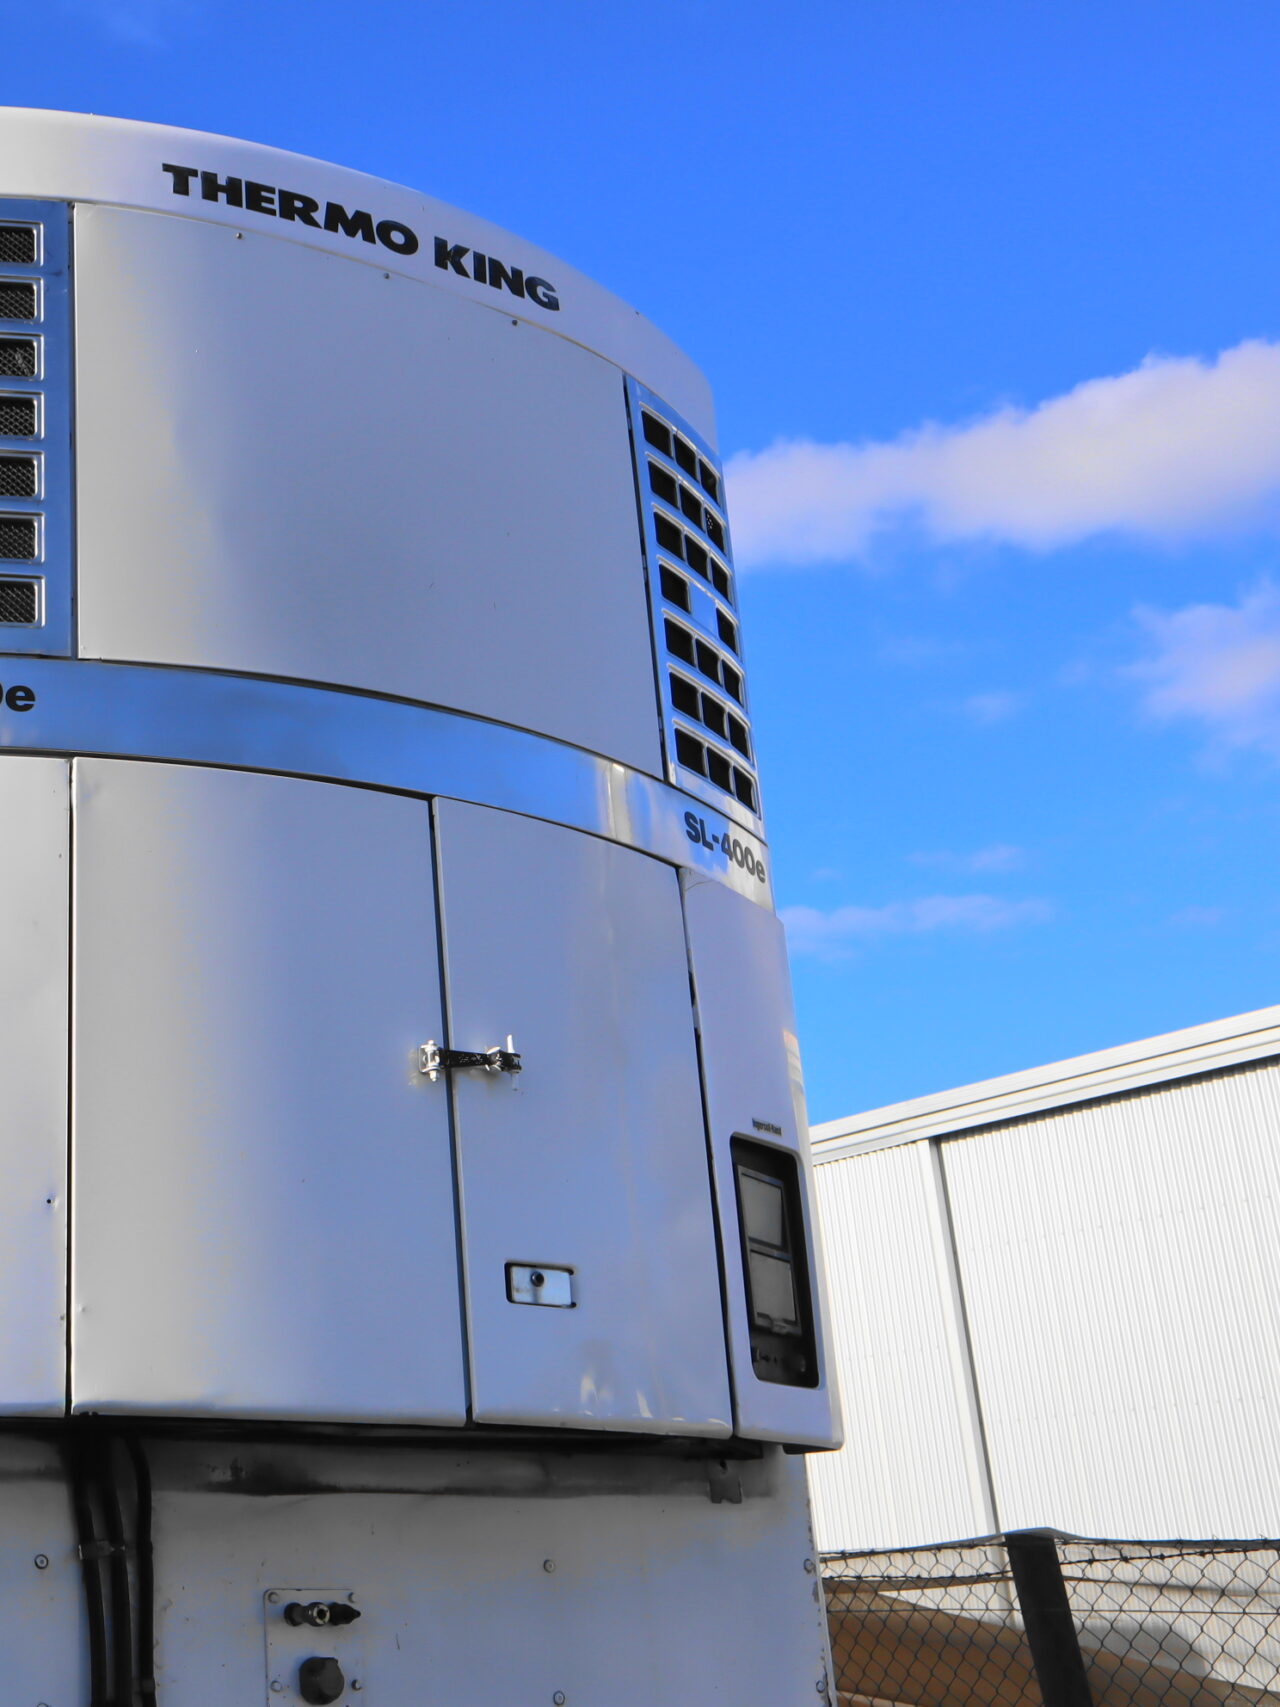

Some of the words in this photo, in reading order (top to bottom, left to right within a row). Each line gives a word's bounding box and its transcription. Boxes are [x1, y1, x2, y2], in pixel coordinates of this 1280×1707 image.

[162, 163, 419, 256] THERMO
[434, 236, 560, 312] KING
[684, 811, 766, 884] SL-400e
